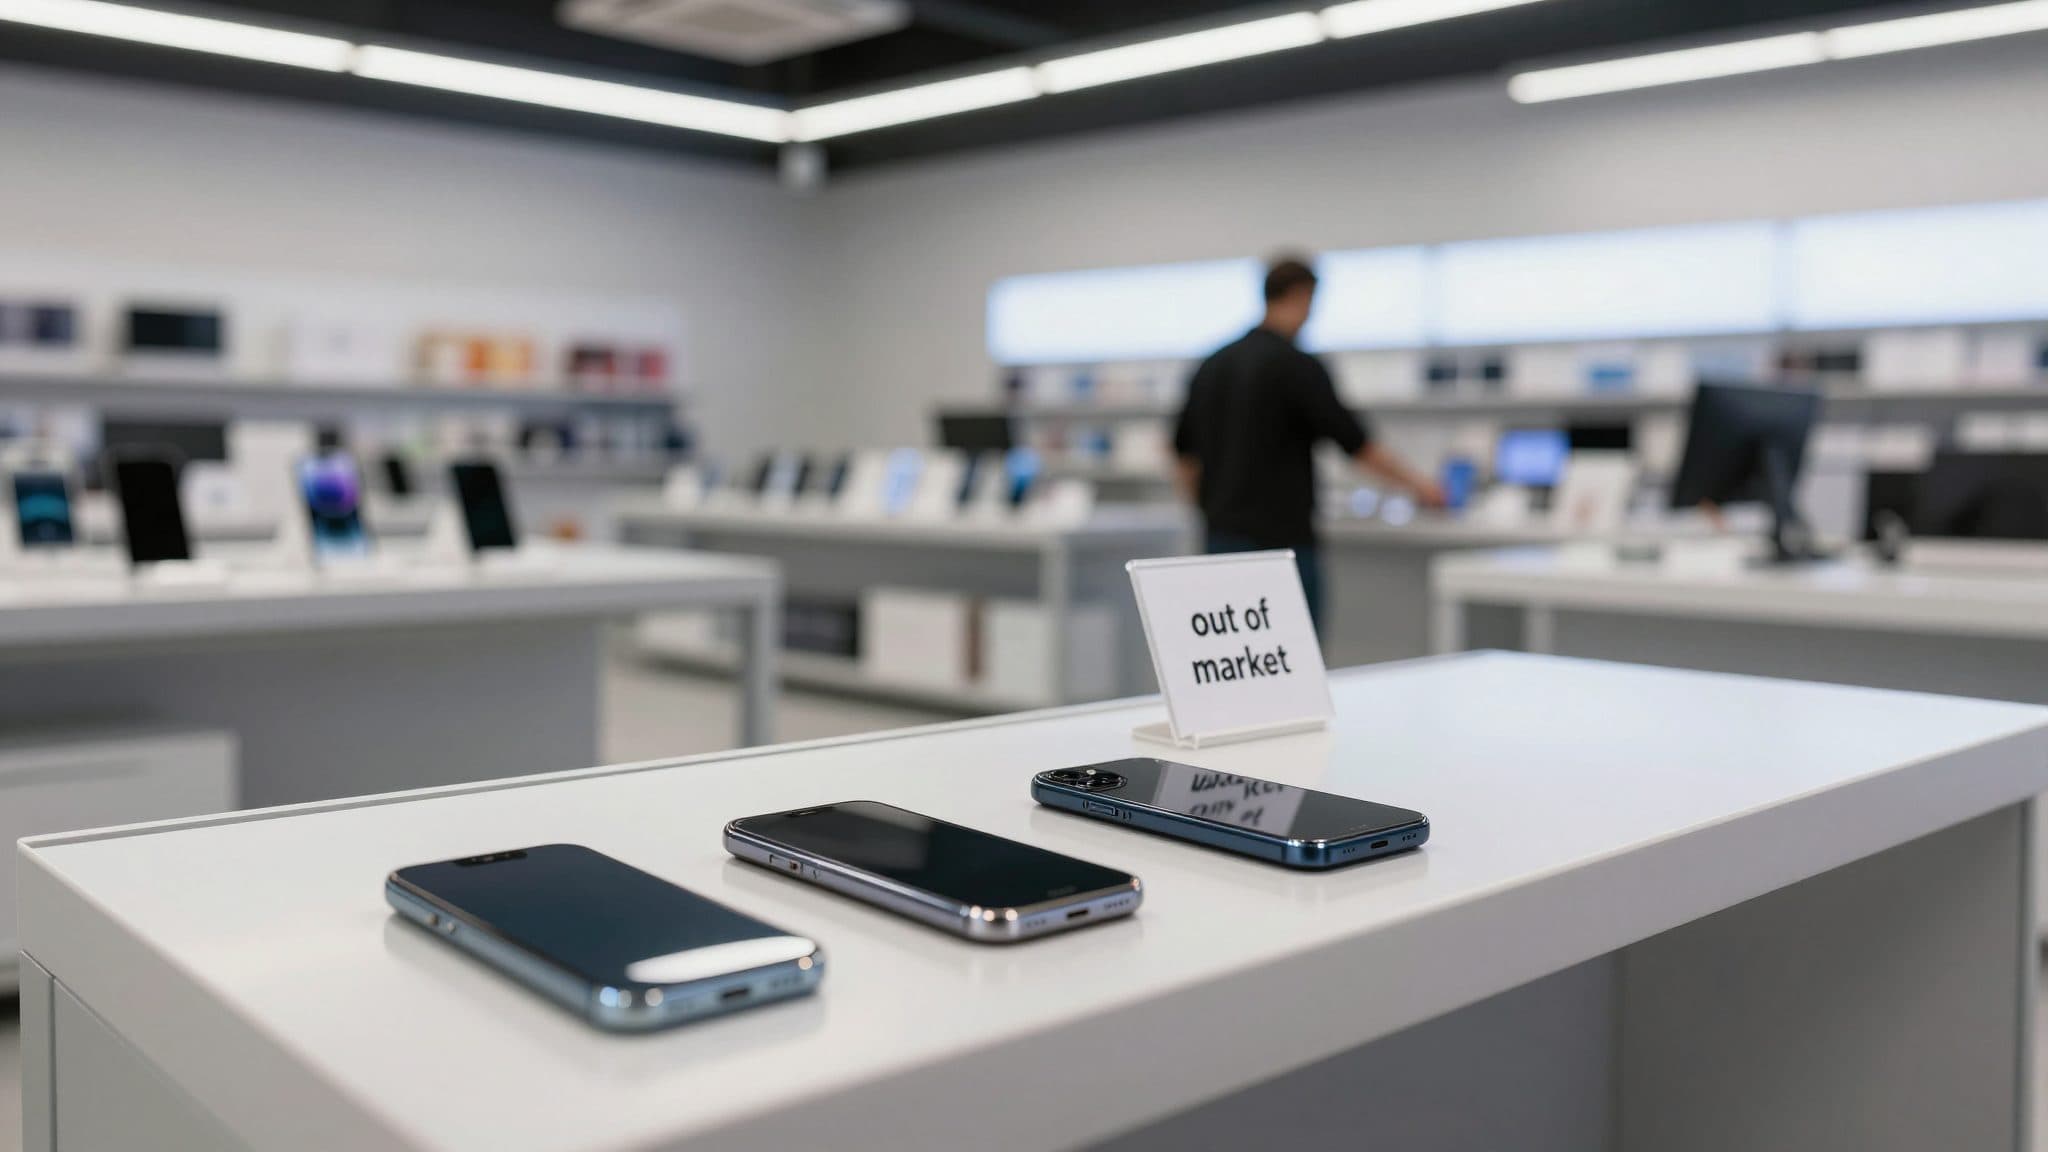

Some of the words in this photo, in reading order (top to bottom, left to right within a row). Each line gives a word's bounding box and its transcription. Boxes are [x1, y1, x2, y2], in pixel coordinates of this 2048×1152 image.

[1191, 604, 1239, 637] out
[1244, 597, 1271, 631] of
[1191, 645, 1292, 685] market
